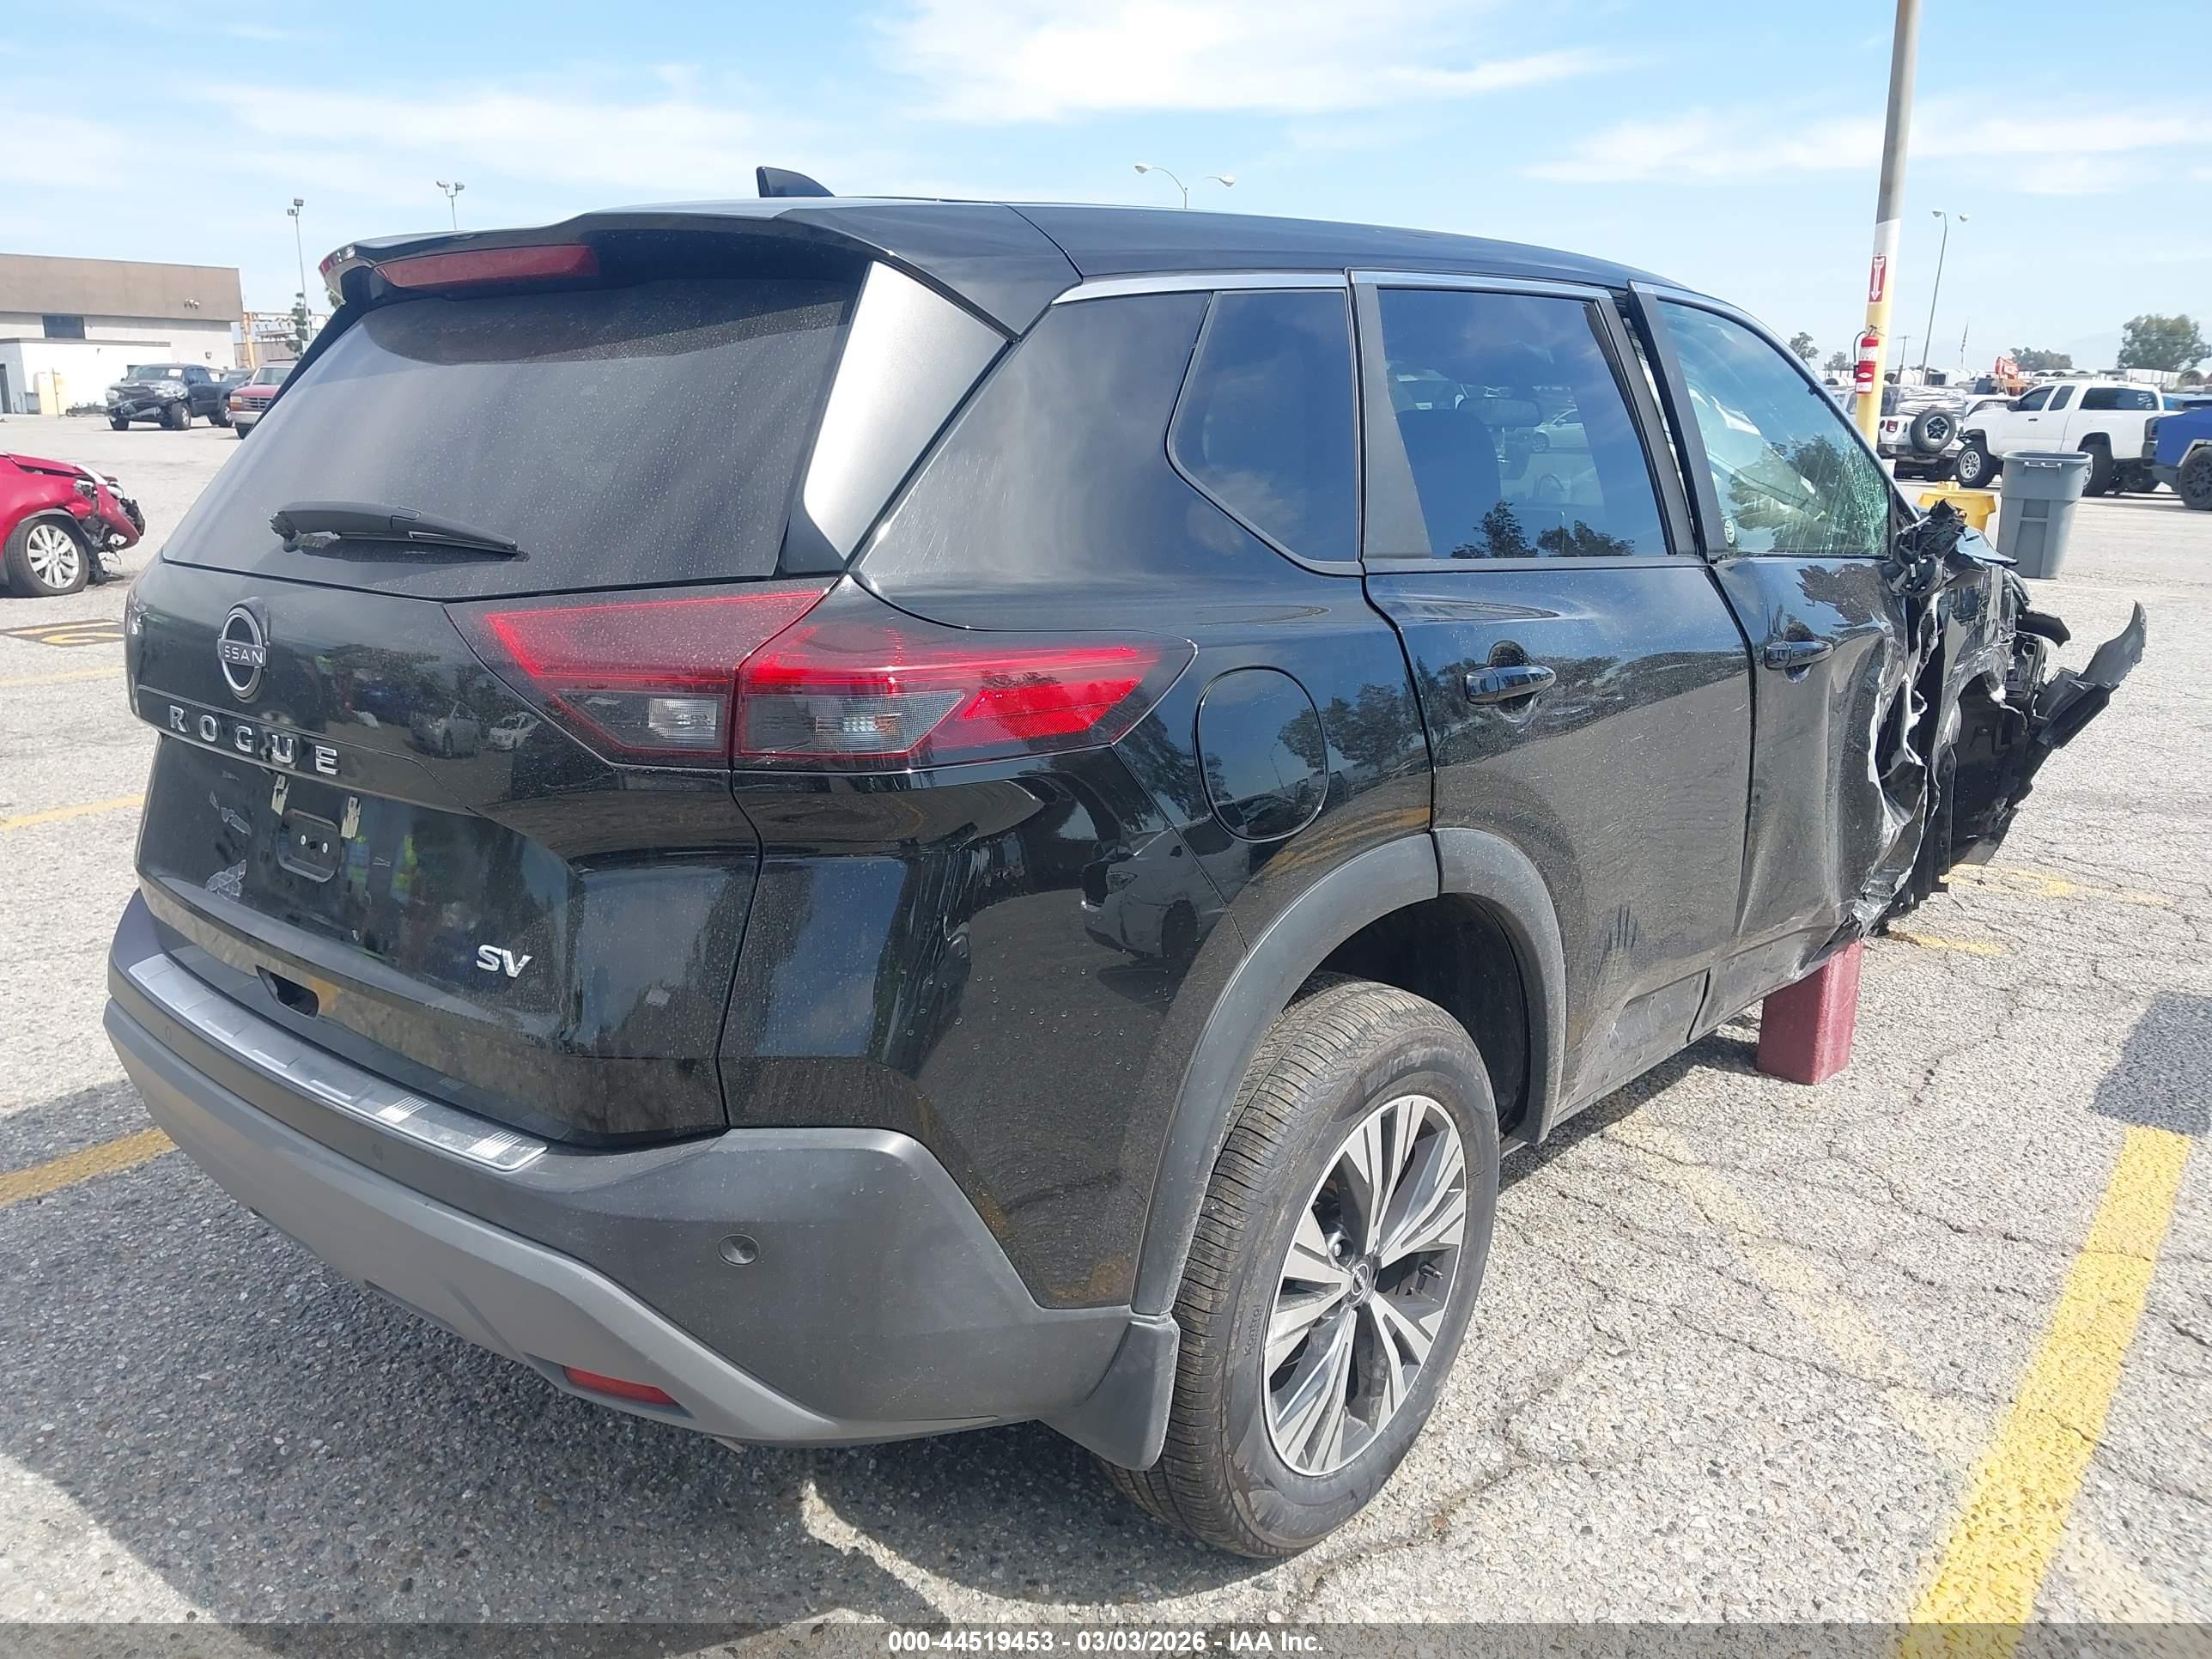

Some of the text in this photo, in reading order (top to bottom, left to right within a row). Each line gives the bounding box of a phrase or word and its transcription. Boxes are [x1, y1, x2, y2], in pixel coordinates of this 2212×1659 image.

[169, 705, 339, 775] ROGUE
[476, 945, 534, 978] SV
[1243, 1304, 1261, 1358] Kontrol
